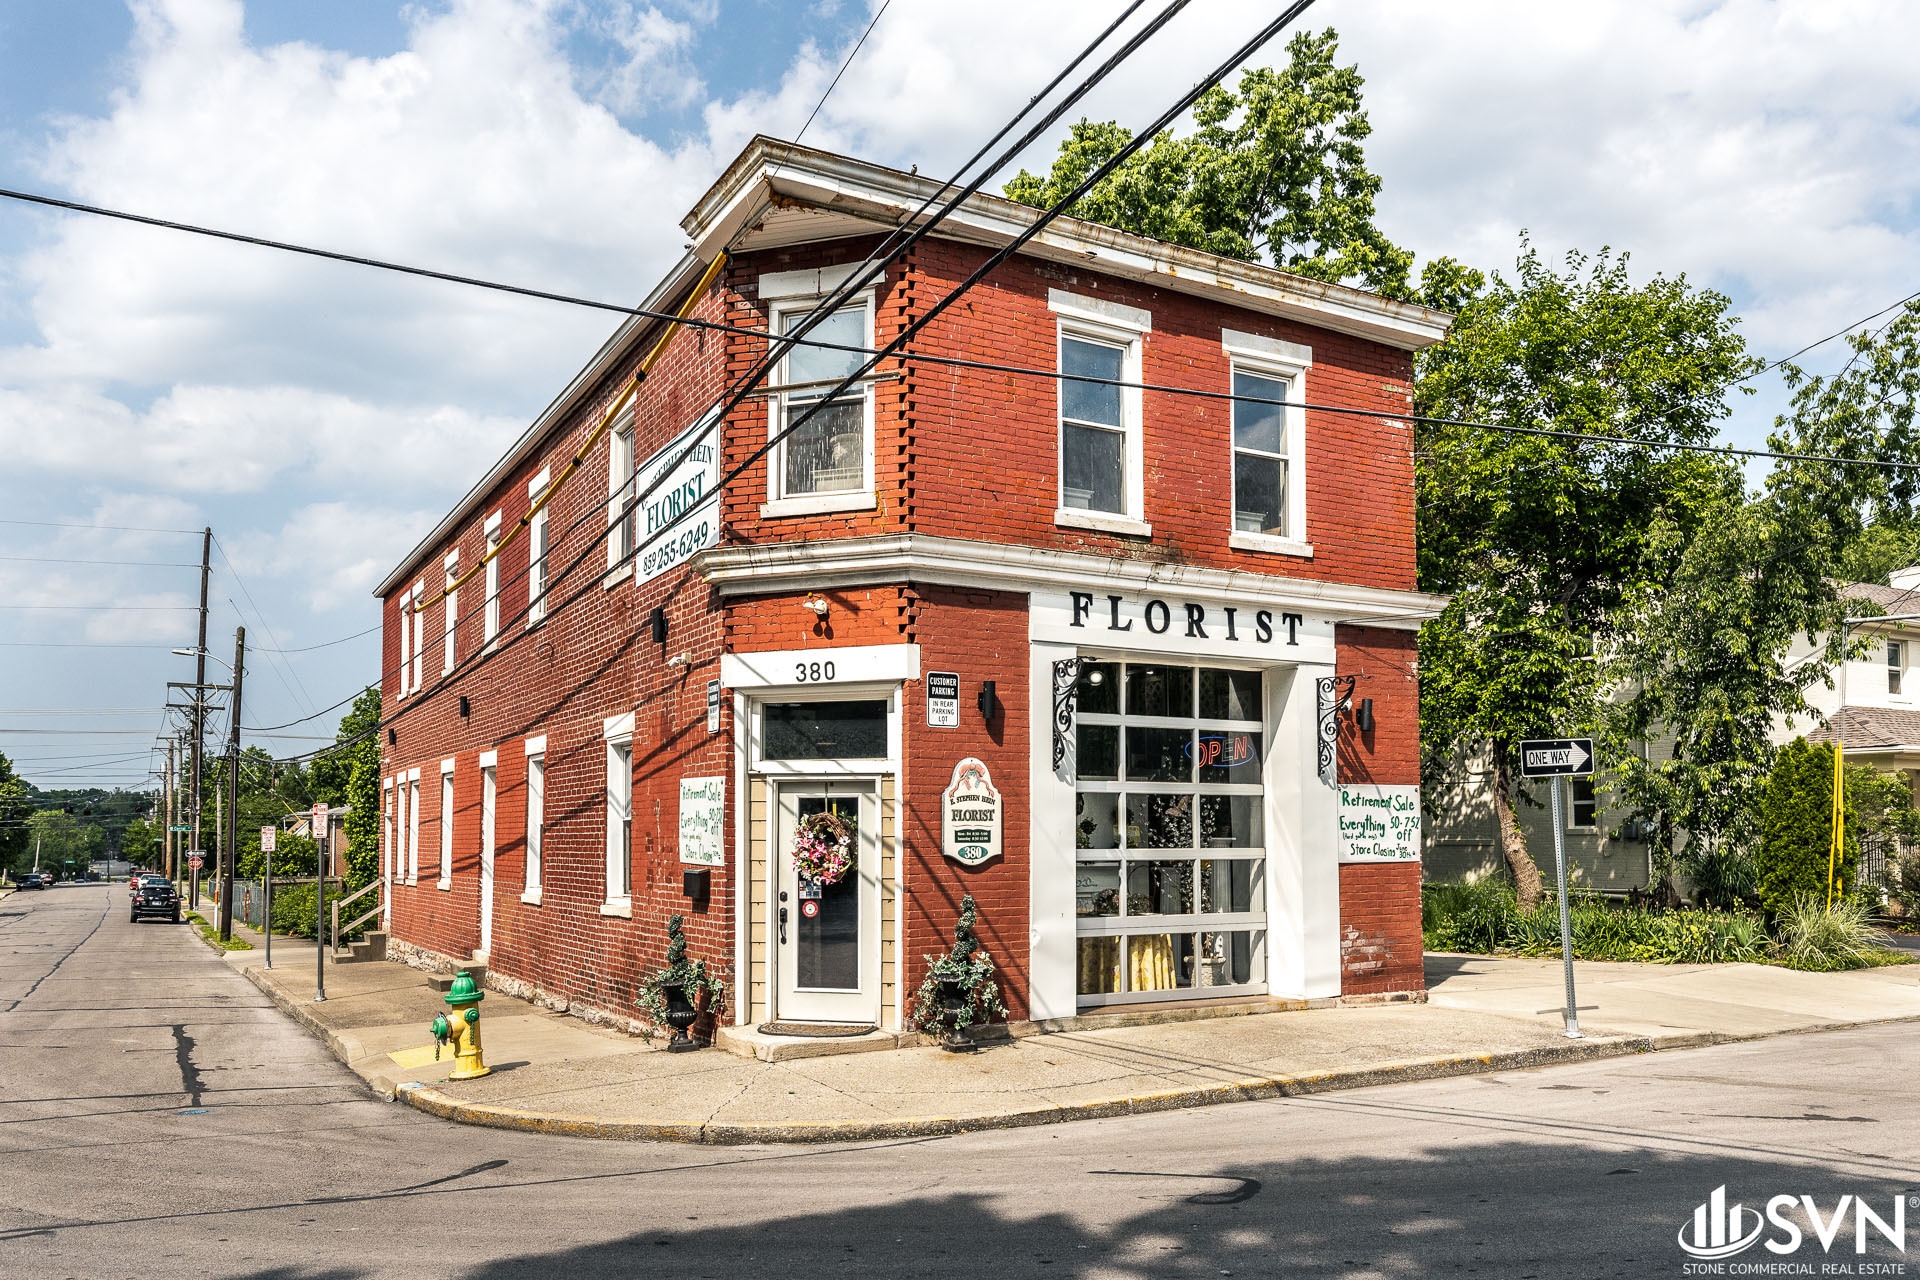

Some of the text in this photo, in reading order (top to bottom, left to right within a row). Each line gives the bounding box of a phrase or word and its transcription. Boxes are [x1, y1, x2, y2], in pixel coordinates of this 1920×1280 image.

[646, 468, 706, 534] FLORIST
[643, 520, 708, 572] 859 255-6249
[1069, 591, 1303, 646] FLORIST
[795, 661, 836, 682] 380
[929, 676, 957, 687] CUSTOMER
[931, 686, 955, 696] PARKING
[931, 707, 955, 716] PARKING
[1198, 736, 1248, 768] OPEN
[1528, 750, 1570, 765] ONE WAY
[682, 781, 722, 802] Retirement Sale
[956, 794, 980, 804] STEPHEN
[1342, 790, 1415, 812] Retirement Sale
[680, 810, 708, 833] Everything
[952, 809, 995, 822] FLORIST
[1339, 814, 1420, 838] Everything 50-75%
[1396, 828, 1412, 842] off
[964, 846, 982, 858] 380
[1350, 843, 1371, 856] Store
[1372, 842, 1396, 856] Closing
